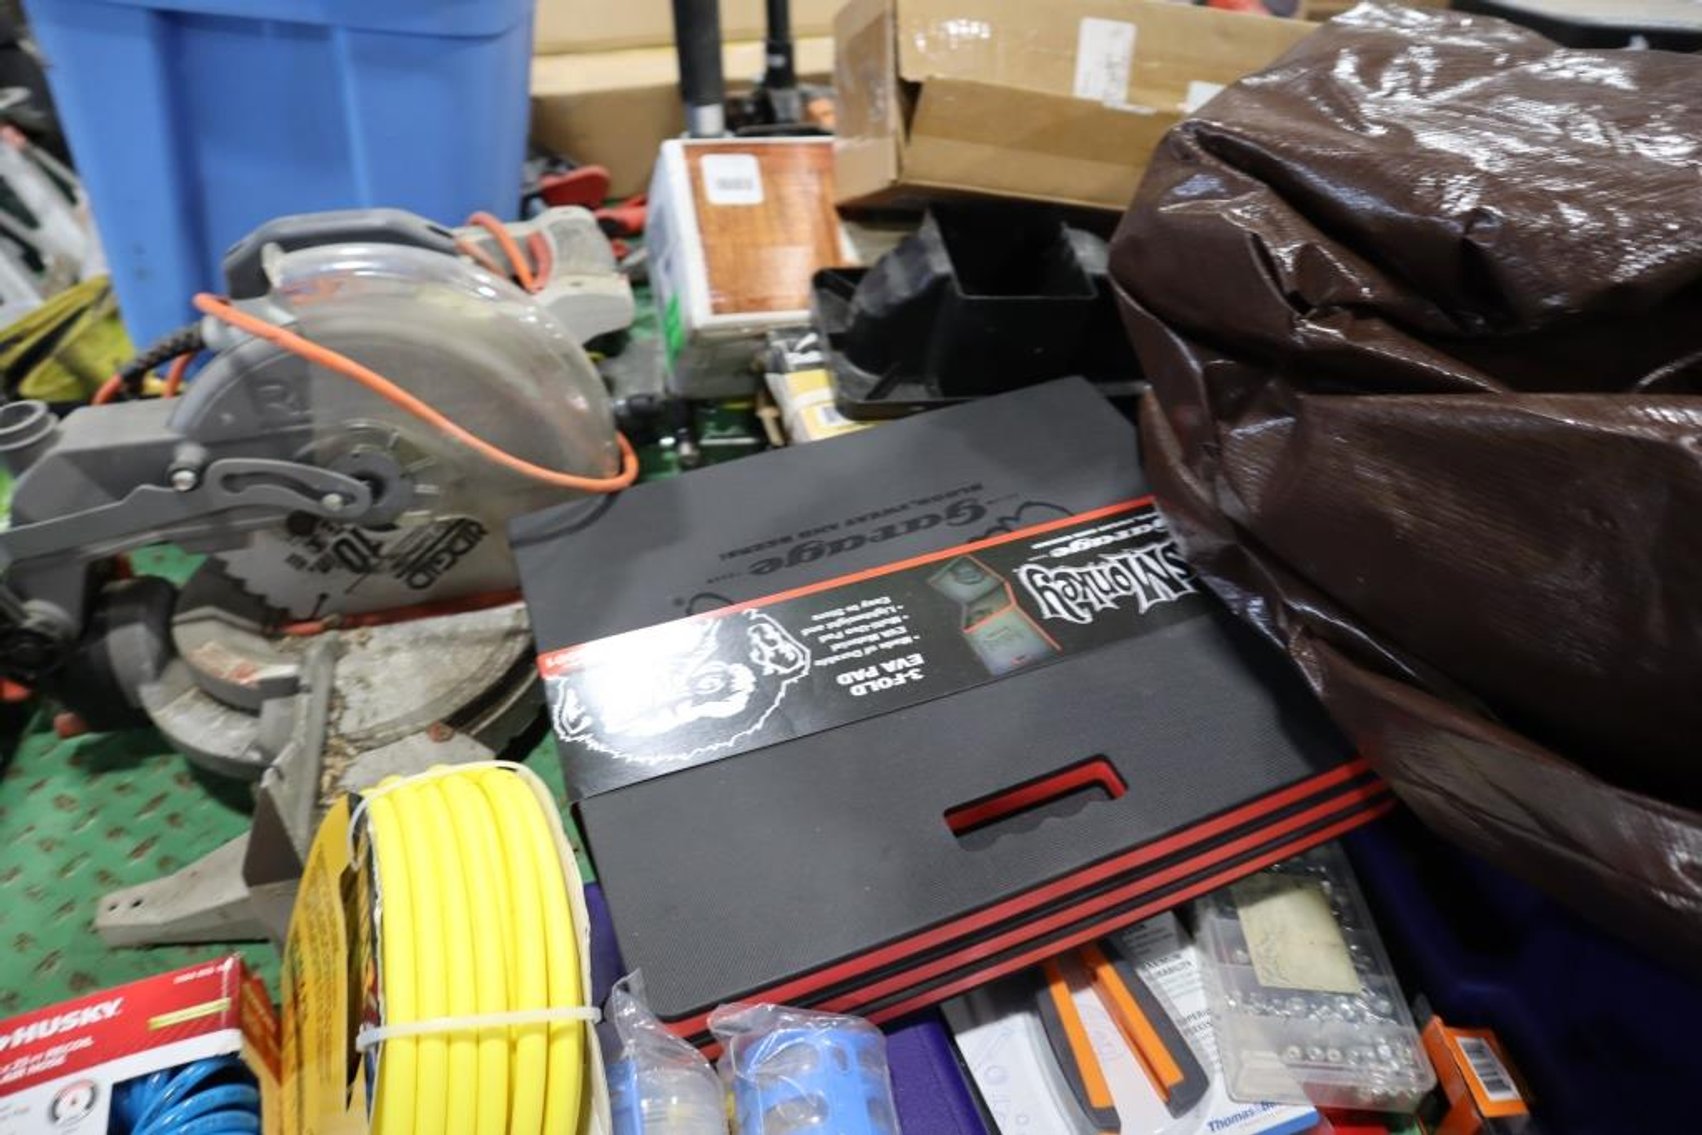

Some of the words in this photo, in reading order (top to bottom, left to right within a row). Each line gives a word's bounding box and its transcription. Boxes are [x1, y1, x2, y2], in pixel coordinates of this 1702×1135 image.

[747, 498, 989, 575] Garage
[836, 666, 879, 684] PAD
[880, 653, 924, 672] EVA
[850, 668, 925, 695] 3-FOLD
[10, 997, 123, 1048] HUSKY
